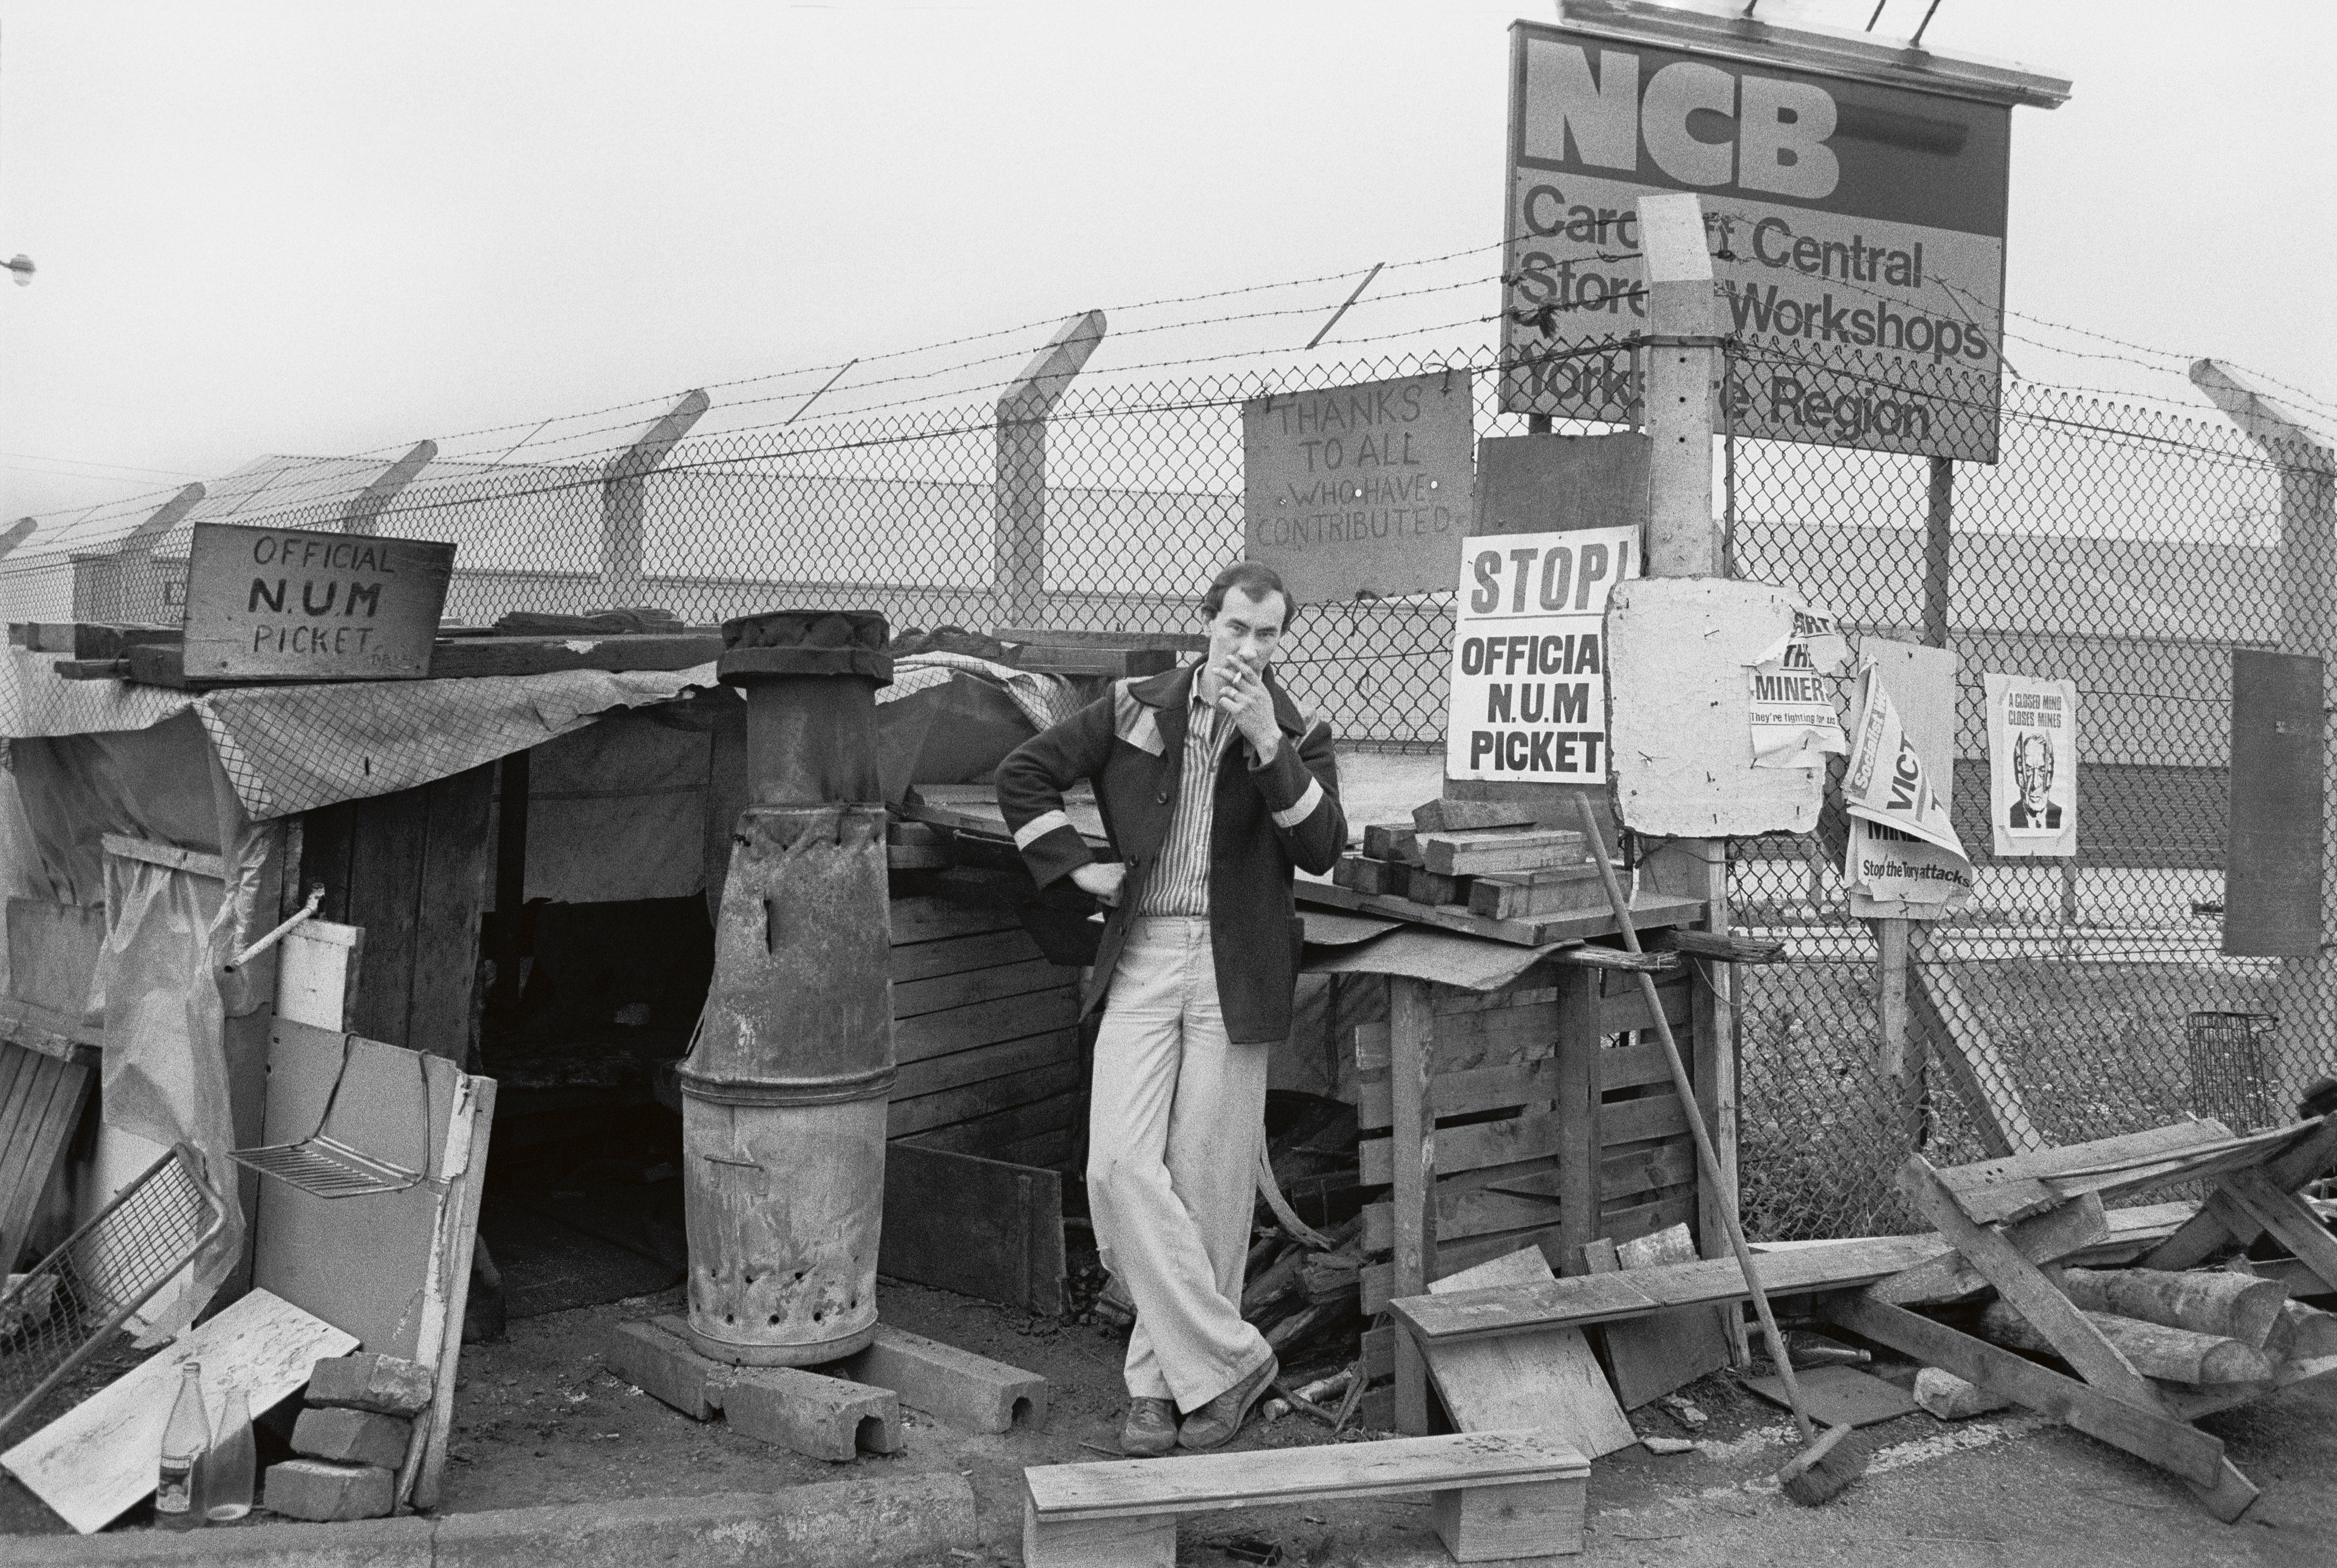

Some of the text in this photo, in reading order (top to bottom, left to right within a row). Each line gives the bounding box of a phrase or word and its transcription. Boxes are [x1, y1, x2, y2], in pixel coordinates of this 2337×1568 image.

[1524, 39, 1840, 199] NCB
[1752, 217, 1921, 288] Central
[1725, 279, 1988, 363] Workshops
[1271, 384, 1422, 434] THANKS
[1770, 375, 1929, 441] Region
[1299, 432, 1420, 471] TO ALL
[1288, 473, 1427, 506] WHO HAVE
[1257, 506, 1449, 546] CONTRIBUTED
[254, 536, 395, 573] OFFICIAL
[1461, 634, 1600, 675] OFFICIA
[1487, 683, 1589, 723] N.U.M
[1755, 675, 1831, 701] MINER
[2009, 692, 2061, 711] A CLOSED MIND
[1751, 713, 1782, 724] They're
[1785, 713, 1815, 724] fighting
[2009, 710, 2061, 728] CLOSES MINES
[1470, 731, 1604, 773] PICKET
[1854, 713, 1884, 789] Socialist
[1863, 860, 1970, 887] Stop the Tory attacks
